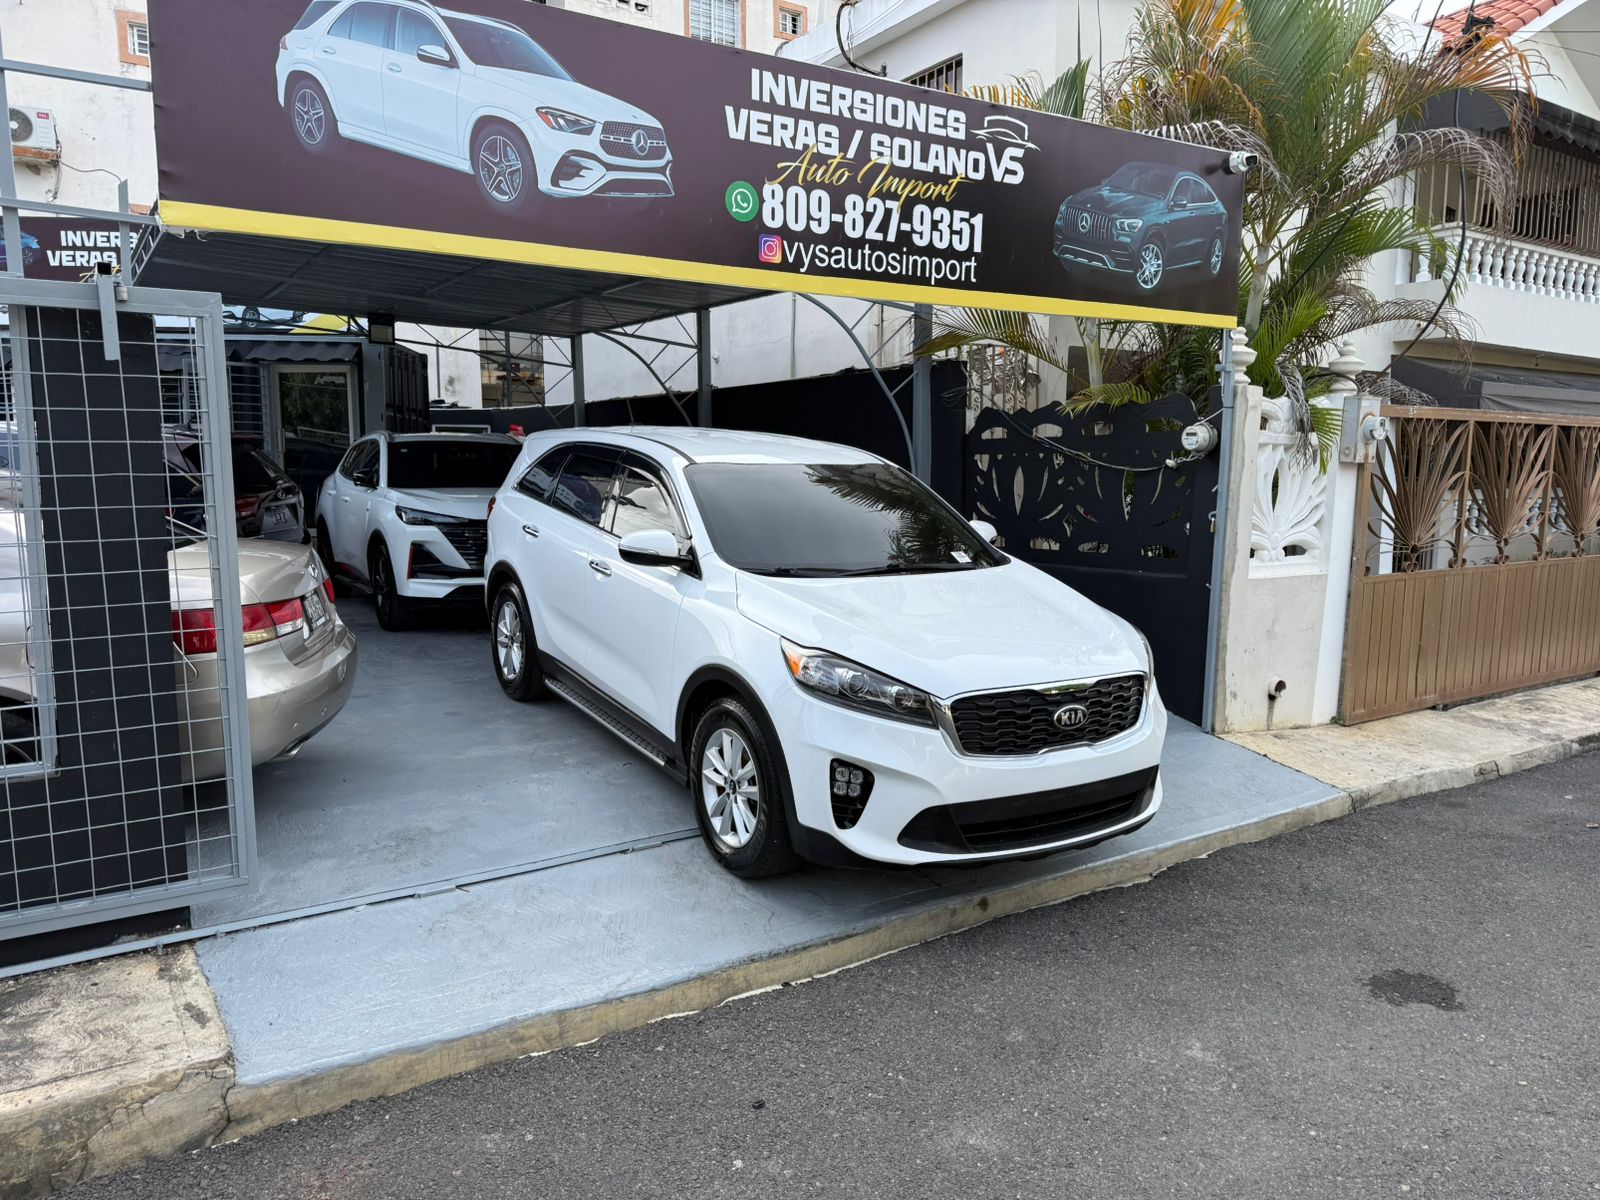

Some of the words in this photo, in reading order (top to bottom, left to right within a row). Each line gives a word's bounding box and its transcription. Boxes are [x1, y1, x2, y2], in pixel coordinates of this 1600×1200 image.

[751, 67, 967, 140] INVERSIONES
[724, 105, 840, 156] VERAS
[870, 132, 986, 181] SOLANO
[985, 142, 1025, 185] VS
[764, 143, 857, 186] Auto
[857, 155, 975, 214] Import
[762, 182, 983, 253] 809-827-9351
[46, 250, 117, 267] VERAS
[783, 239, 977, 285] vysautosimport
[1061, 710, 1083, 725] KIA
